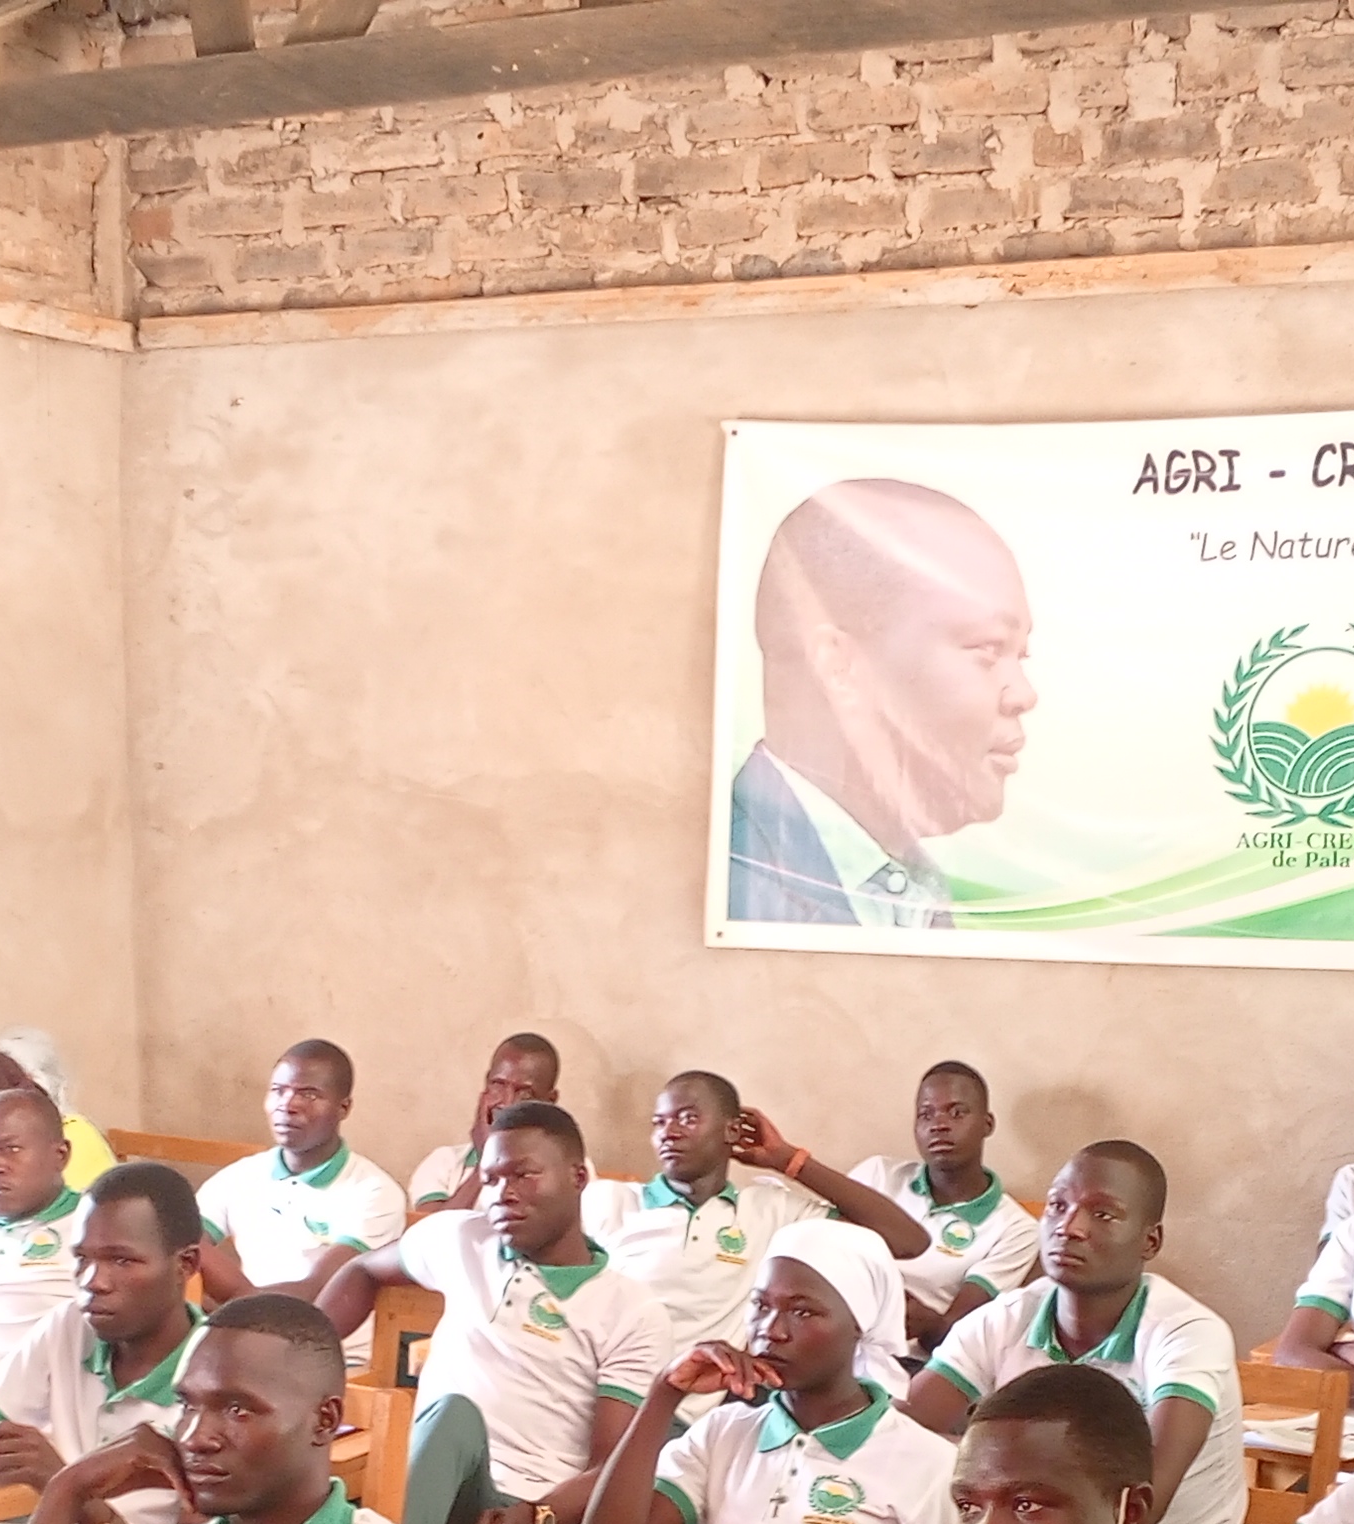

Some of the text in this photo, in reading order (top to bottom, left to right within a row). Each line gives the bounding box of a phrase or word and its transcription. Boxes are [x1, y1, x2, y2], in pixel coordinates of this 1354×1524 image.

[1131, 449, 1242, 495] AGRI
[1268, 469, 1287, 479] -
[1190, 531, 1238, 563] "Le
[1271, 850, 1351, 869] de Pala
